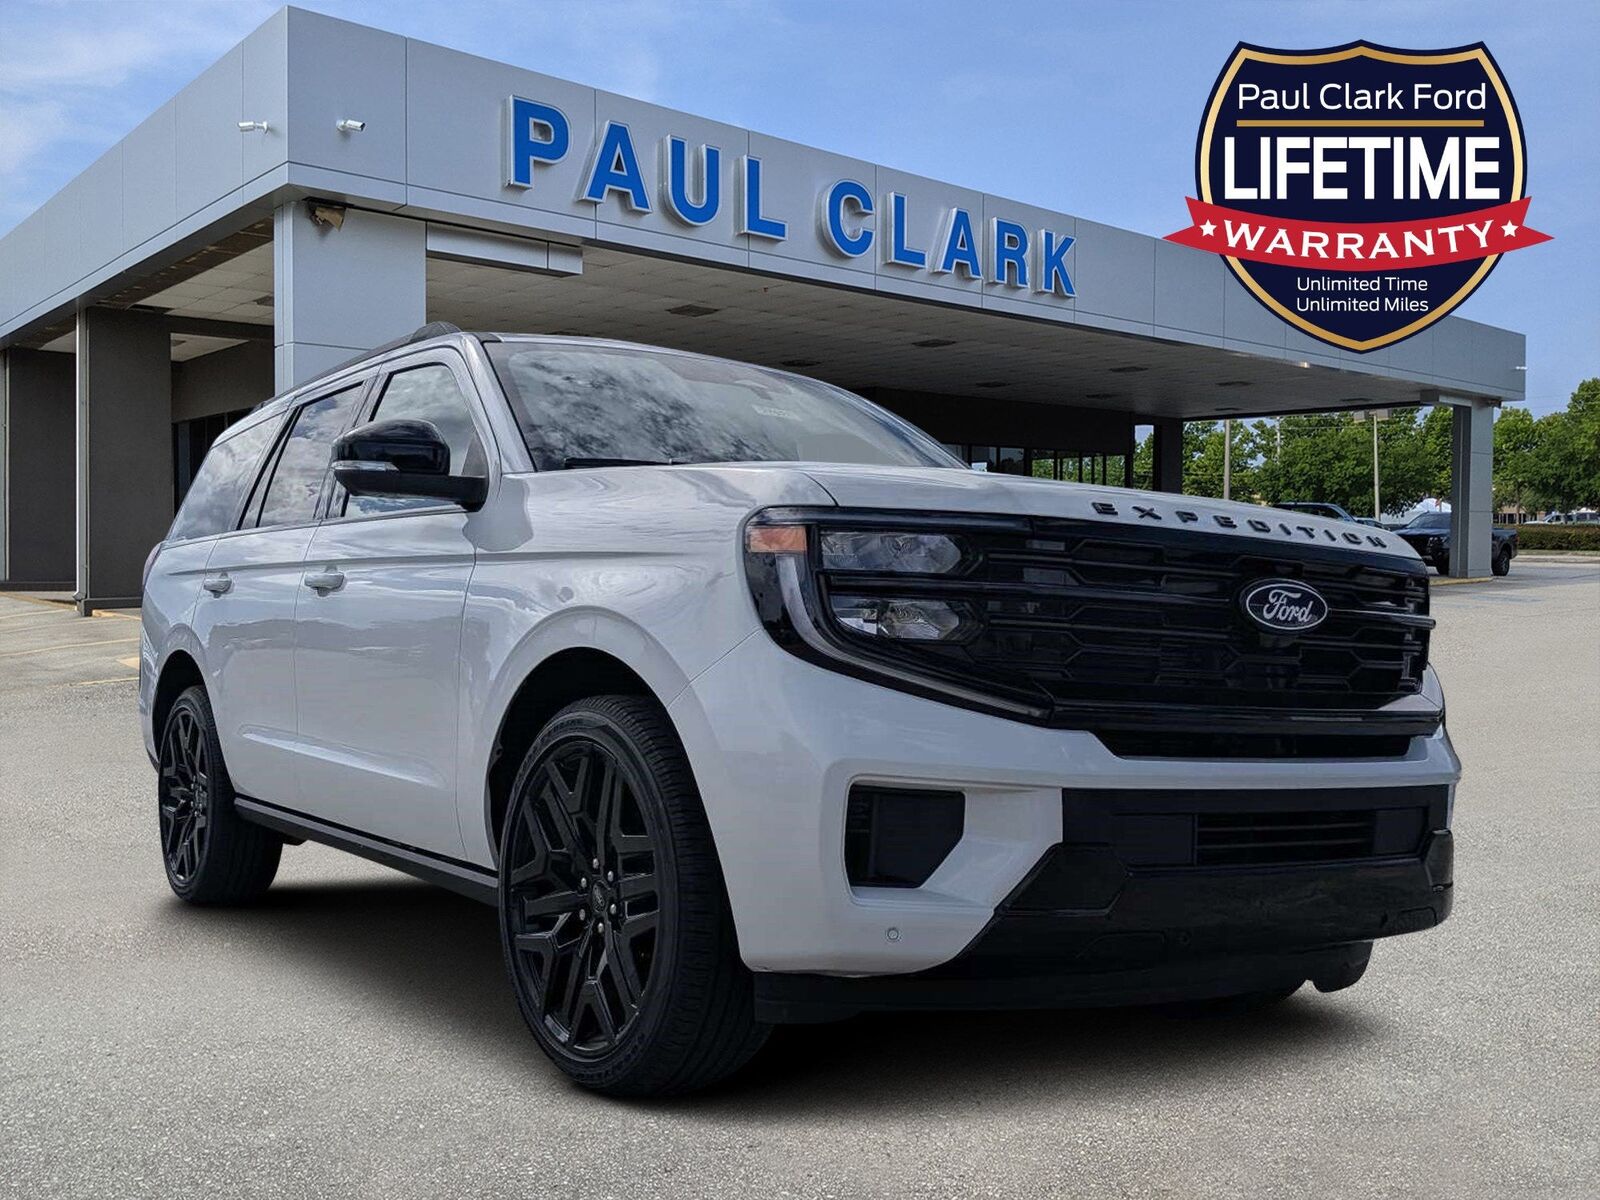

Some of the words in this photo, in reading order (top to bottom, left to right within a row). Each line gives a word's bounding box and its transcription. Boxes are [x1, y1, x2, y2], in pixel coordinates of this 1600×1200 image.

[504, 95, 789, 241] PAUL
[822, 178, 1077, 298] CLARK
[1091, 502, 1388, 548] EXPEDITION
[1263, 589, 1314, 623] Ford
